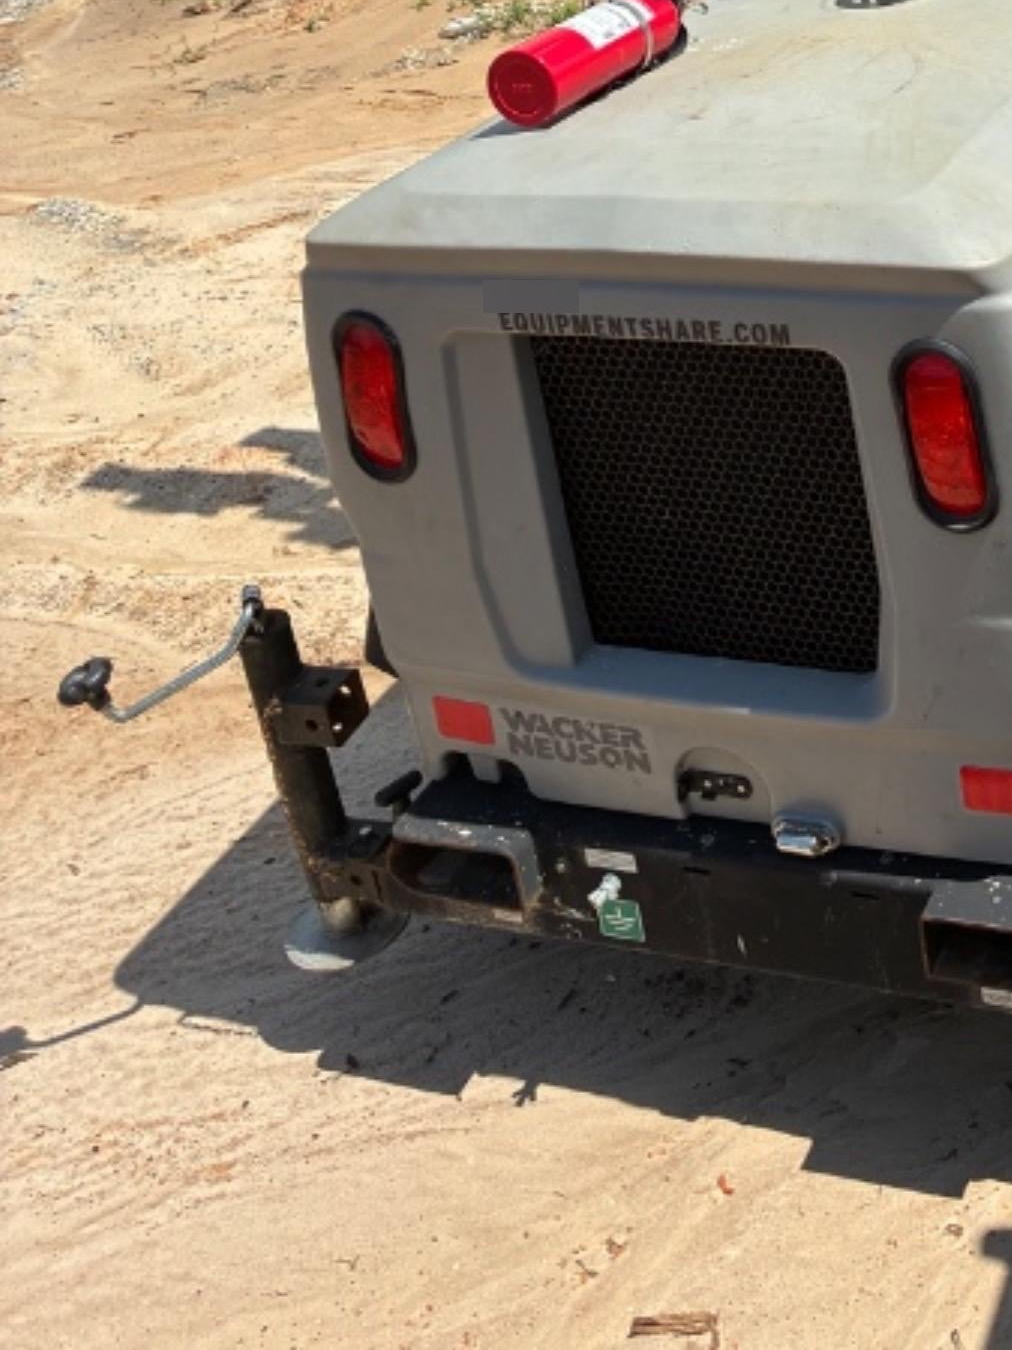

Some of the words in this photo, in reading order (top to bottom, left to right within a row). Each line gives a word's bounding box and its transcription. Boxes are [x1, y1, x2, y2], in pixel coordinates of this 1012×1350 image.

[499, 313, 790, 345] EQUIPMENTSHARE.COM
[499, 706, 647, 751] WACKER
[507, 731, 653, 775] NEUSON
